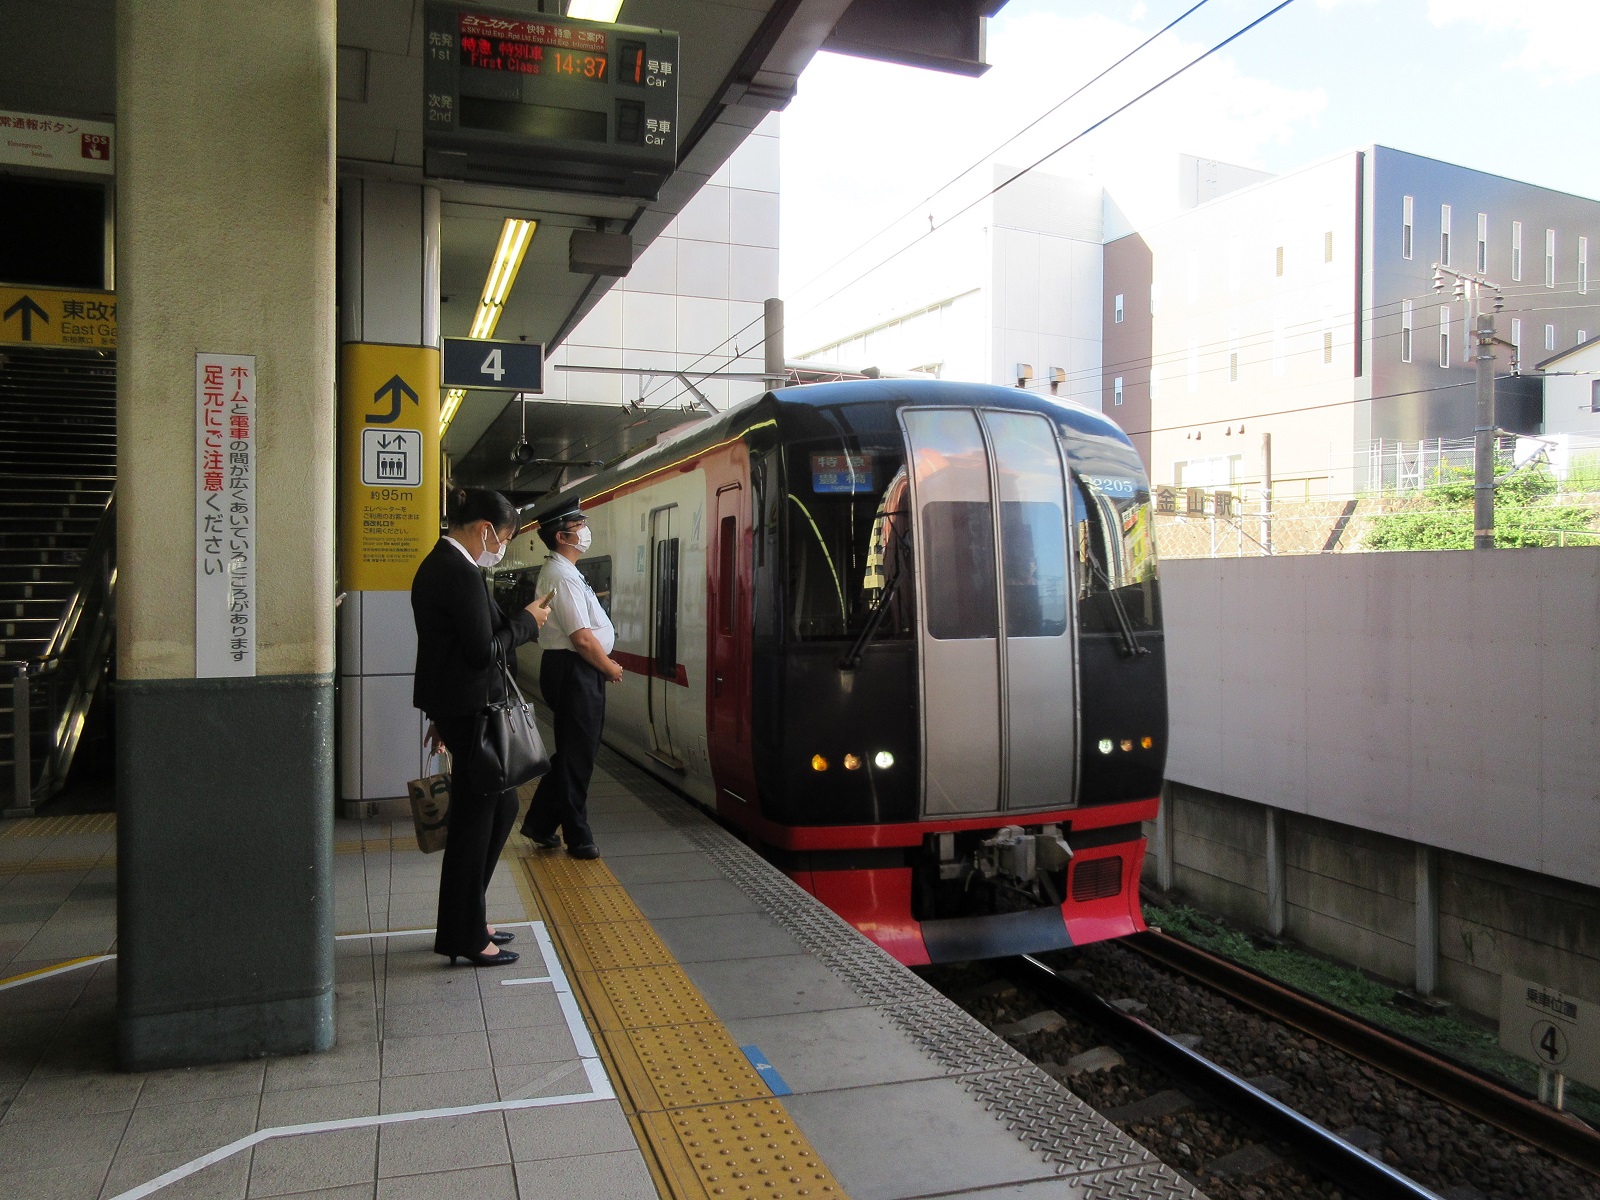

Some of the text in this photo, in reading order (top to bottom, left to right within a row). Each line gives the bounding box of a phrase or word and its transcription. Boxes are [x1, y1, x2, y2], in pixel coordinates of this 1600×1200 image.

[428, 31, 453, 47] 先発
[578, 30, 604, 43] ご案内
[461, 37, 492, 55] 特急
[431, 48, 450, 60] 1st
[471, 52, 540, 75] First Class
[555, 52, 607, 79] 14:37
[634, 49, 643, 83] 1
[647, 60, 672, 75] 号車
[646, 75, 667, 88] Car
[428, 93, 453, 109] 次発
[429, 109, 451, 122] 2nd
[646, 119, 671, 134] 号車
[84, 134, 107, 145] SOS
[645, 134, 666, 146] Car
[62, 322, 95, 335] East
[480, 349, 506, 381] 4
[203, 365, 224, 575] 足元にご注意ください
[1093, 478, 1133, 493] 2205
[370, 488, 413, 501] 約95m
[1157, 486, 1232, 517] 金山駅
[363, 505, 407, 513] エレベーターを
[1540, 1026, 1559, 1061] 4
